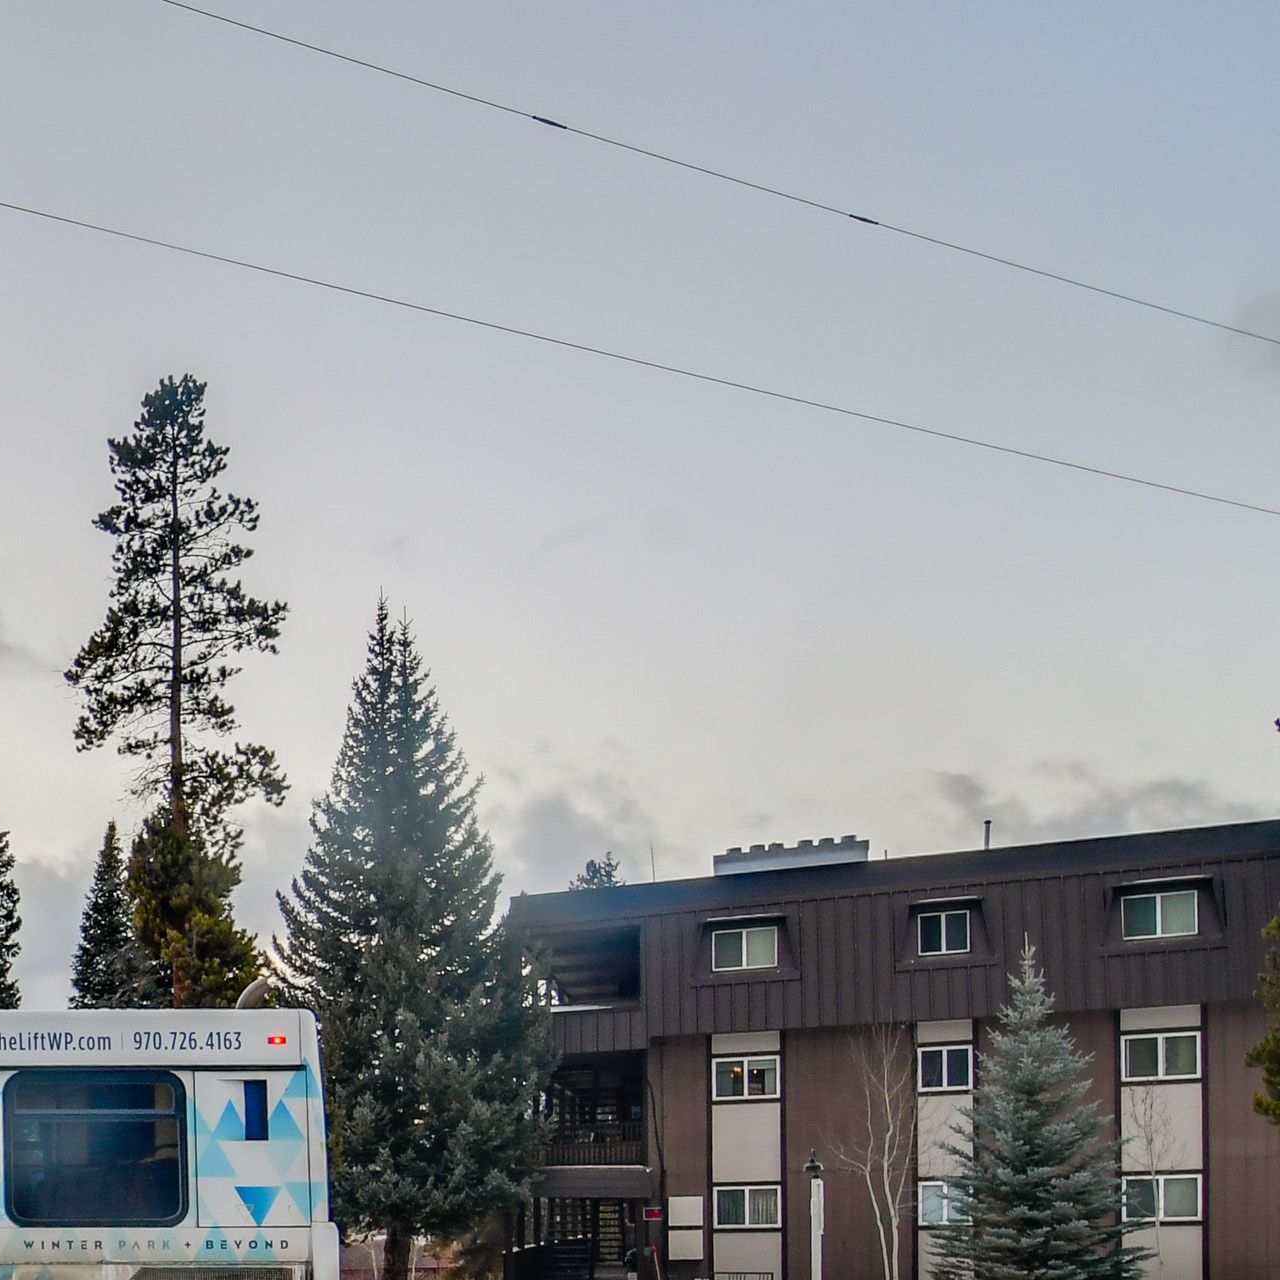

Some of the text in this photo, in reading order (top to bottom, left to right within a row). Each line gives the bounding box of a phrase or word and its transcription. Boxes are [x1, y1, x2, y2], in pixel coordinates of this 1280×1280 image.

[133, 1031, 242, 1050] 970.726.4163
[23, 1240, 103, 1250] WINTER
[118, 1240, 171, 1250] PARK
[205, 1240, 289, 1250] BEYOND
